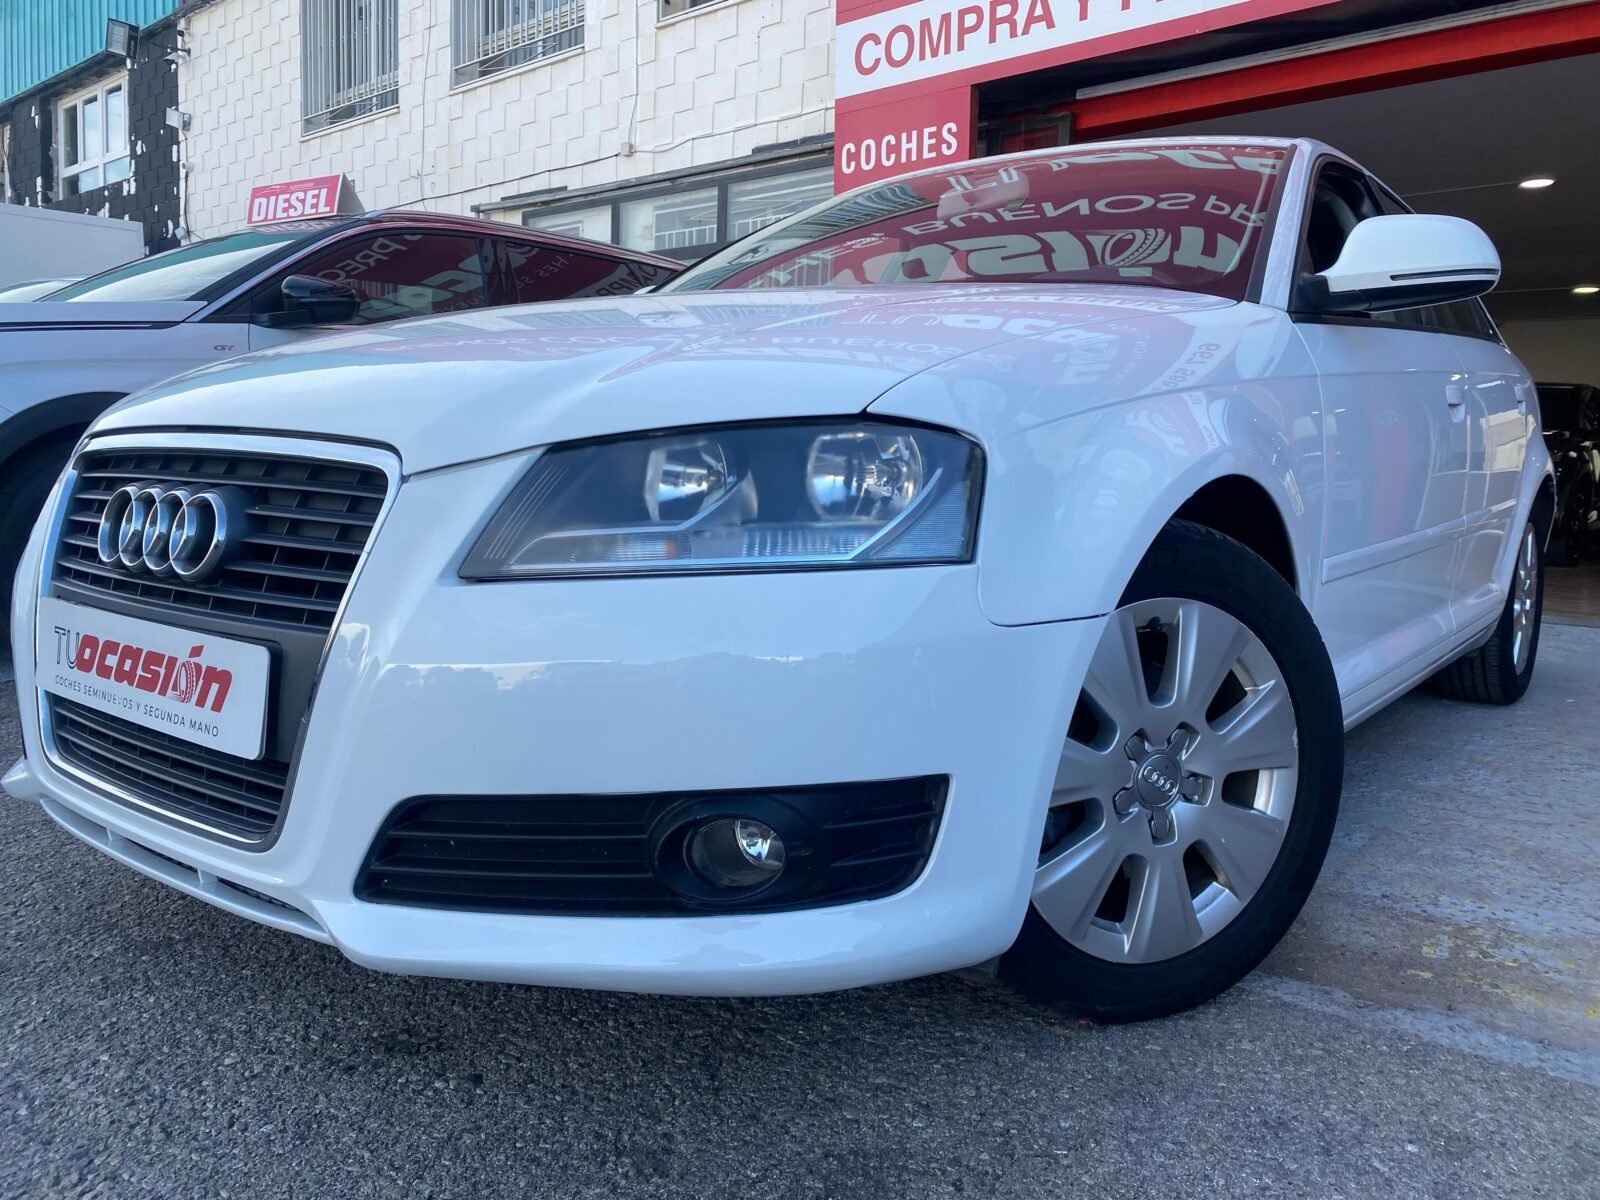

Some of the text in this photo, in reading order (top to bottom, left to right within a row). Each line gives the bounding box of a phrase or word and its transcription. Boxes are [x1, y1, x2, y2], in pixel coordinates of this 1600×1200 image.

[854, 0, 1056, 76] COMPRA
[841, 122, 958, 175] COCHES
[251, 187, 330, 222] DIESEL
[55, 674, 219, 737] COCHES SEMINUEVOS Y SEGUNDA MANO
